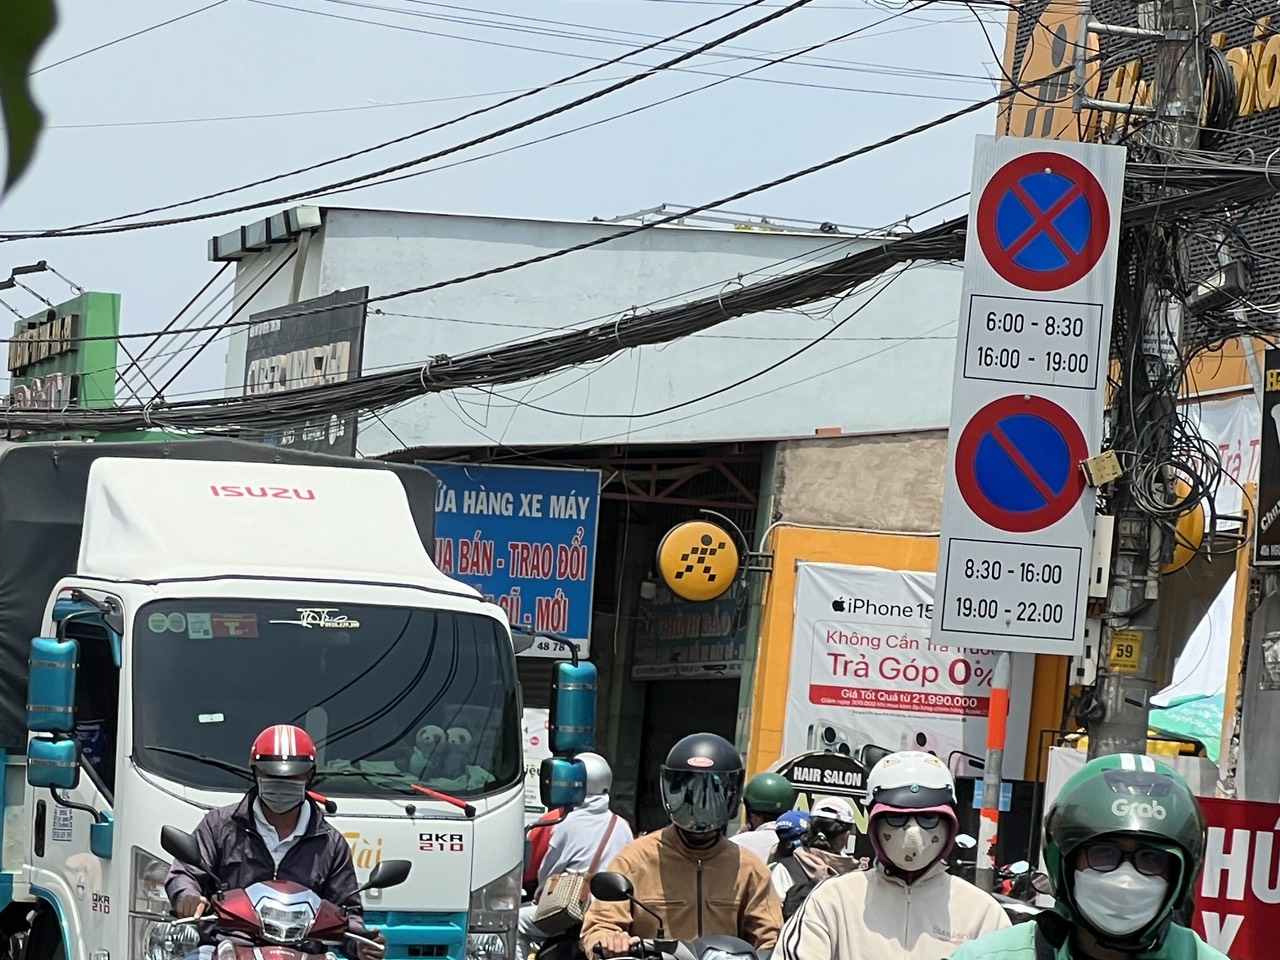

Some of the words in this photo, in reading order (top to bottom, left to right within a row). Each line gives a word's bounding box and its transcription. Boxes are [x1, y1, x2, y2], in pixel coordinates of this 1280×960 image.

[986, 311, 1025, 334] 6:00
[1045, 316, 1083, 337] 8:30
[977, 346, 1020, 369] 16:00
[1046, 351, 1089, 373] 19:00
[1218, 439, 1243, 487] Trả
[209, 485, 317, 501] ISUZU
[463, 485, 514, 516] HÀNG
[519, 493, 543, 517] XE
[550, 489, 590, 520] MÁY
[458, 530, 494, 576] BÁN
[508, 542, 554, 579] TRAO
[556, 526, 587, 581] ĐỔI
[965, 558, 1002, 581] 8:30
[1020, 562, 1062, 584] 16:00
[535, 587, 568, 634] MỚI
[847, 597, 913, 617] iPhone
[956, 597, 998, 619] 19:00
[1016, 601, 1063, 623] 22:00
[826, 630, 881, 650] Không
[886, 632, 920, 650] Cần
[1116, 644, 1133, 658] 59
[826, 652, 869, 678] Trả
[878, 656, 939, 688] Góp
[841, 689, 858, 699] Giá
[860, 690, 876, 701] Tốt
[878, 691, 898, 702] Quá
[900, 692, 911, 702] từ
[912, 693, 978, 708] 21.990.000
[793, 766, 822, 783] HAIR
[823, 769, 862, 787] SALON
[1111, 798, 1167, 821] Grab
[419, 842, 464, 852] 210
[92, 902, 110, 914] 210
